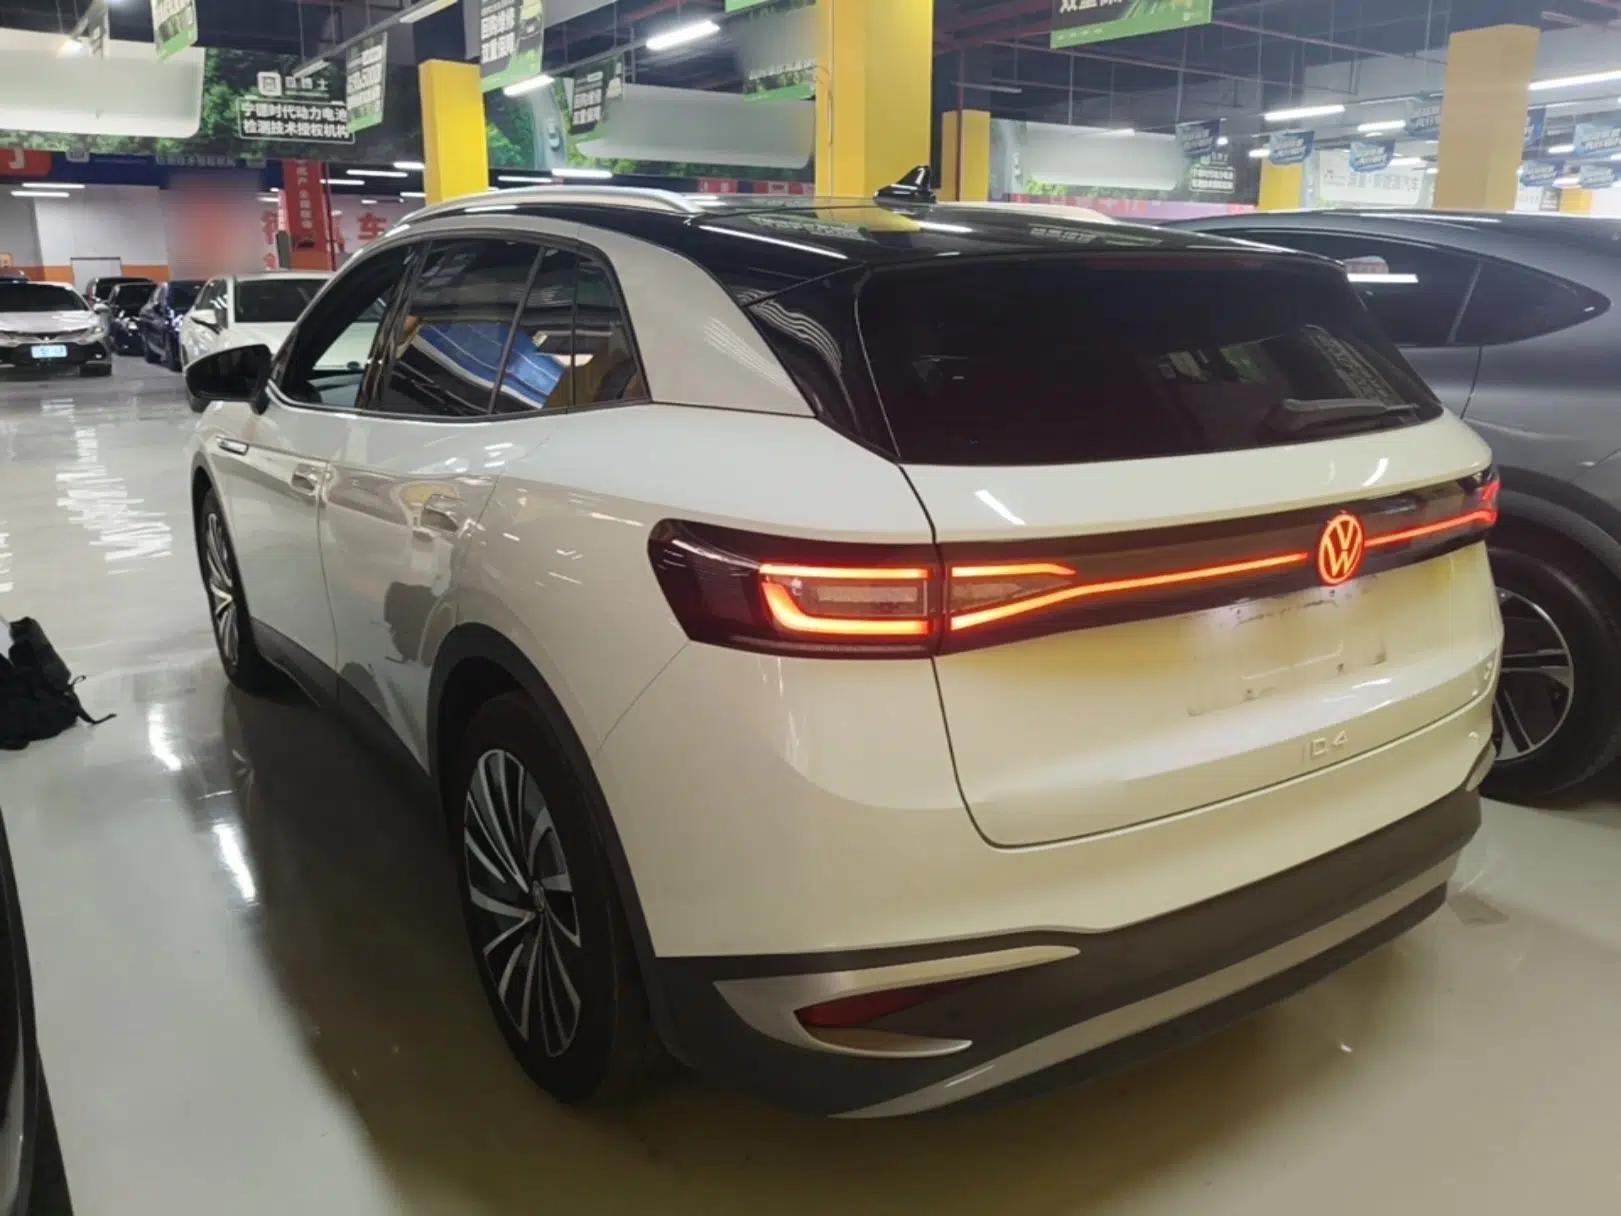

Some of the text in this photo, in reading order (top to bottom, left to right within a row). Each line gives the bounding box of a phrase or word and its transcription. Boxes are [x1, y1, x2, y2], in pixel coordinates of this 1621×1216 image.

[241, 103, 348, 122] 宁德时代动力电池
